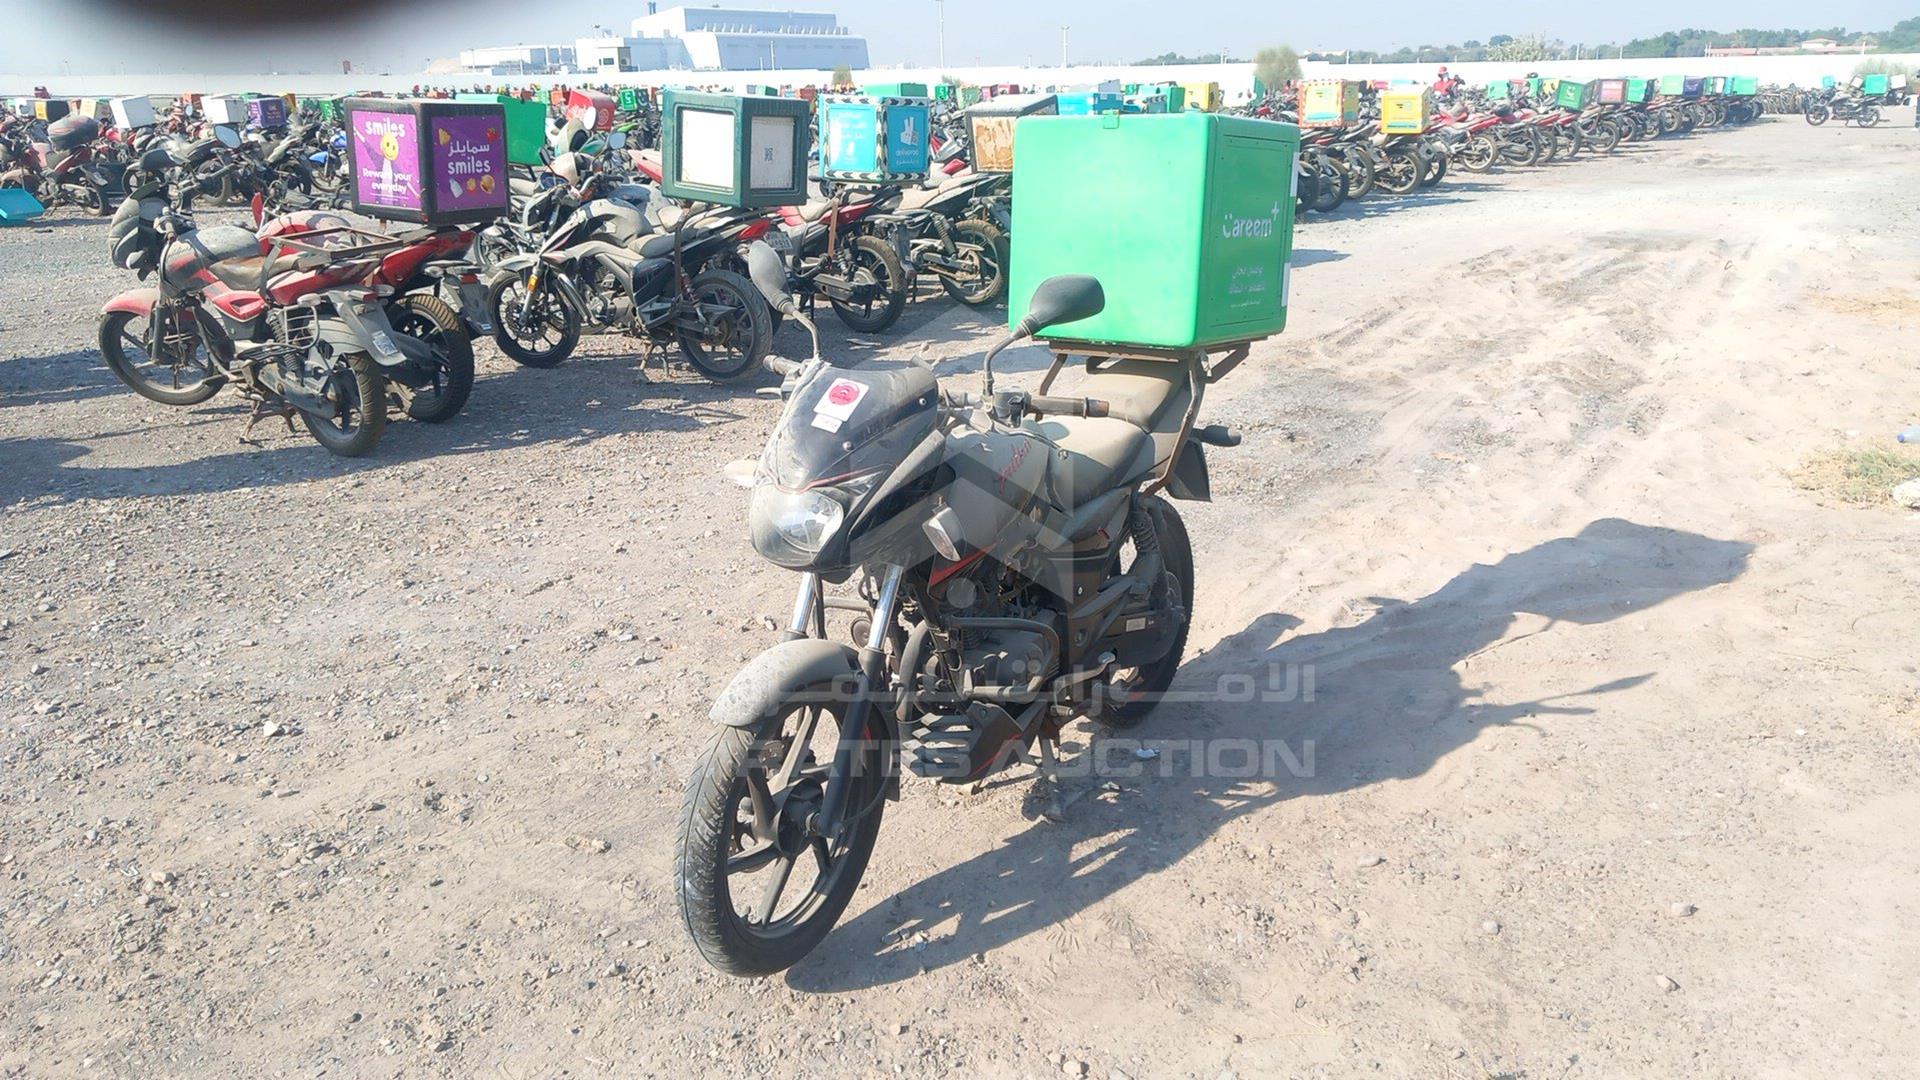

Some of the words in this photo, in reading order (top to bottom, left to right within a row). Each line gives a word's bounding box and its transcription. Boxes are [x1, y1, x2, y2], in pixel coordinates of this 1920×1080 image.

[365, 117, 406, 138] smiles
[448, 141, 490, 157] سمايلز
[448, 156, 491, 175] smiles
